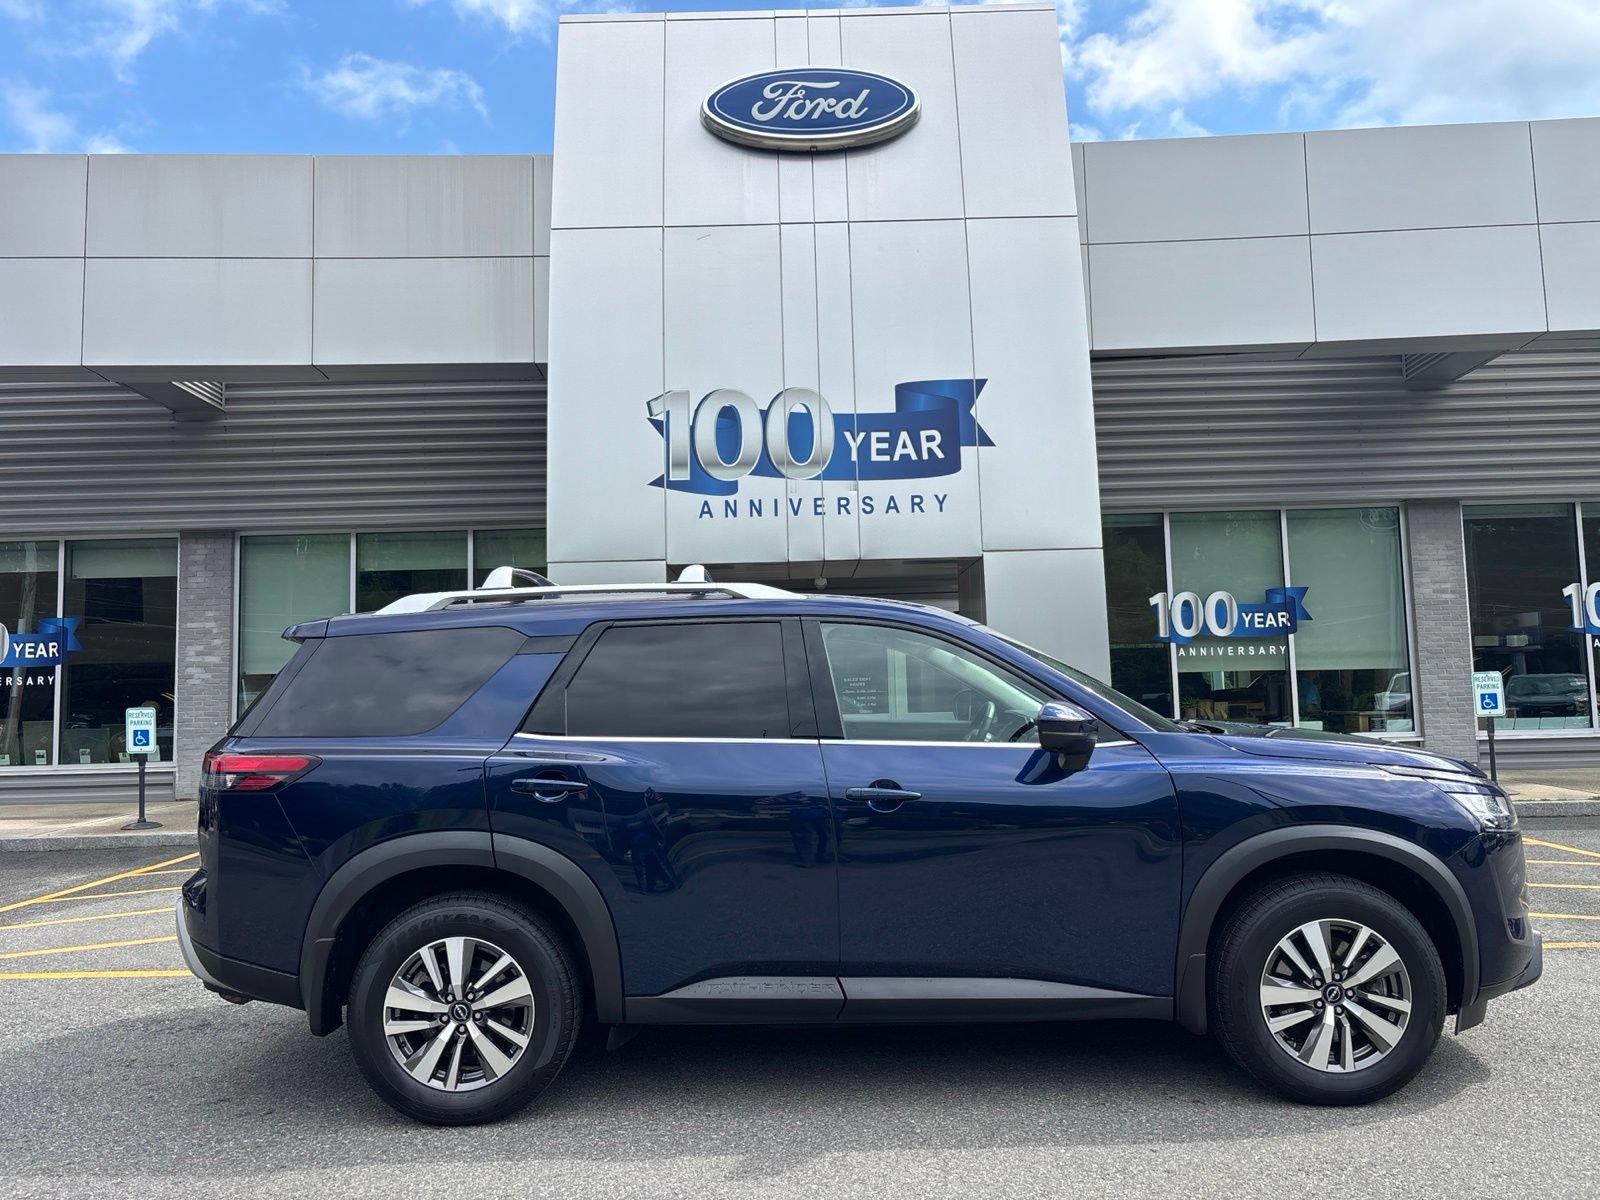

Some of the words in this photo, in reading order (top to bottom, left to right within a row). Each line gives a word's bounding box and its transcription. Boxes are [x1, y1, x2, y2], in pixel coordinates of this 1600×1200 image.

[751, 80, 870, 121] Ford
[646, 387, 835, 481] 100
[843, 429, 945, 462] YEAR
[699, 494, 948, 519] ANNIVERSARY
[1149, 591, 1238, 637] 100
[1242, 612, 1291, 628] YEAR
[13, 642, 59, 658] YEAR
[1178, 645, 1287, 657] ANNIVERSARY
[128, 711, 154, 719] RESERVED
[707, 983, 835, 993] PATHFINDER
